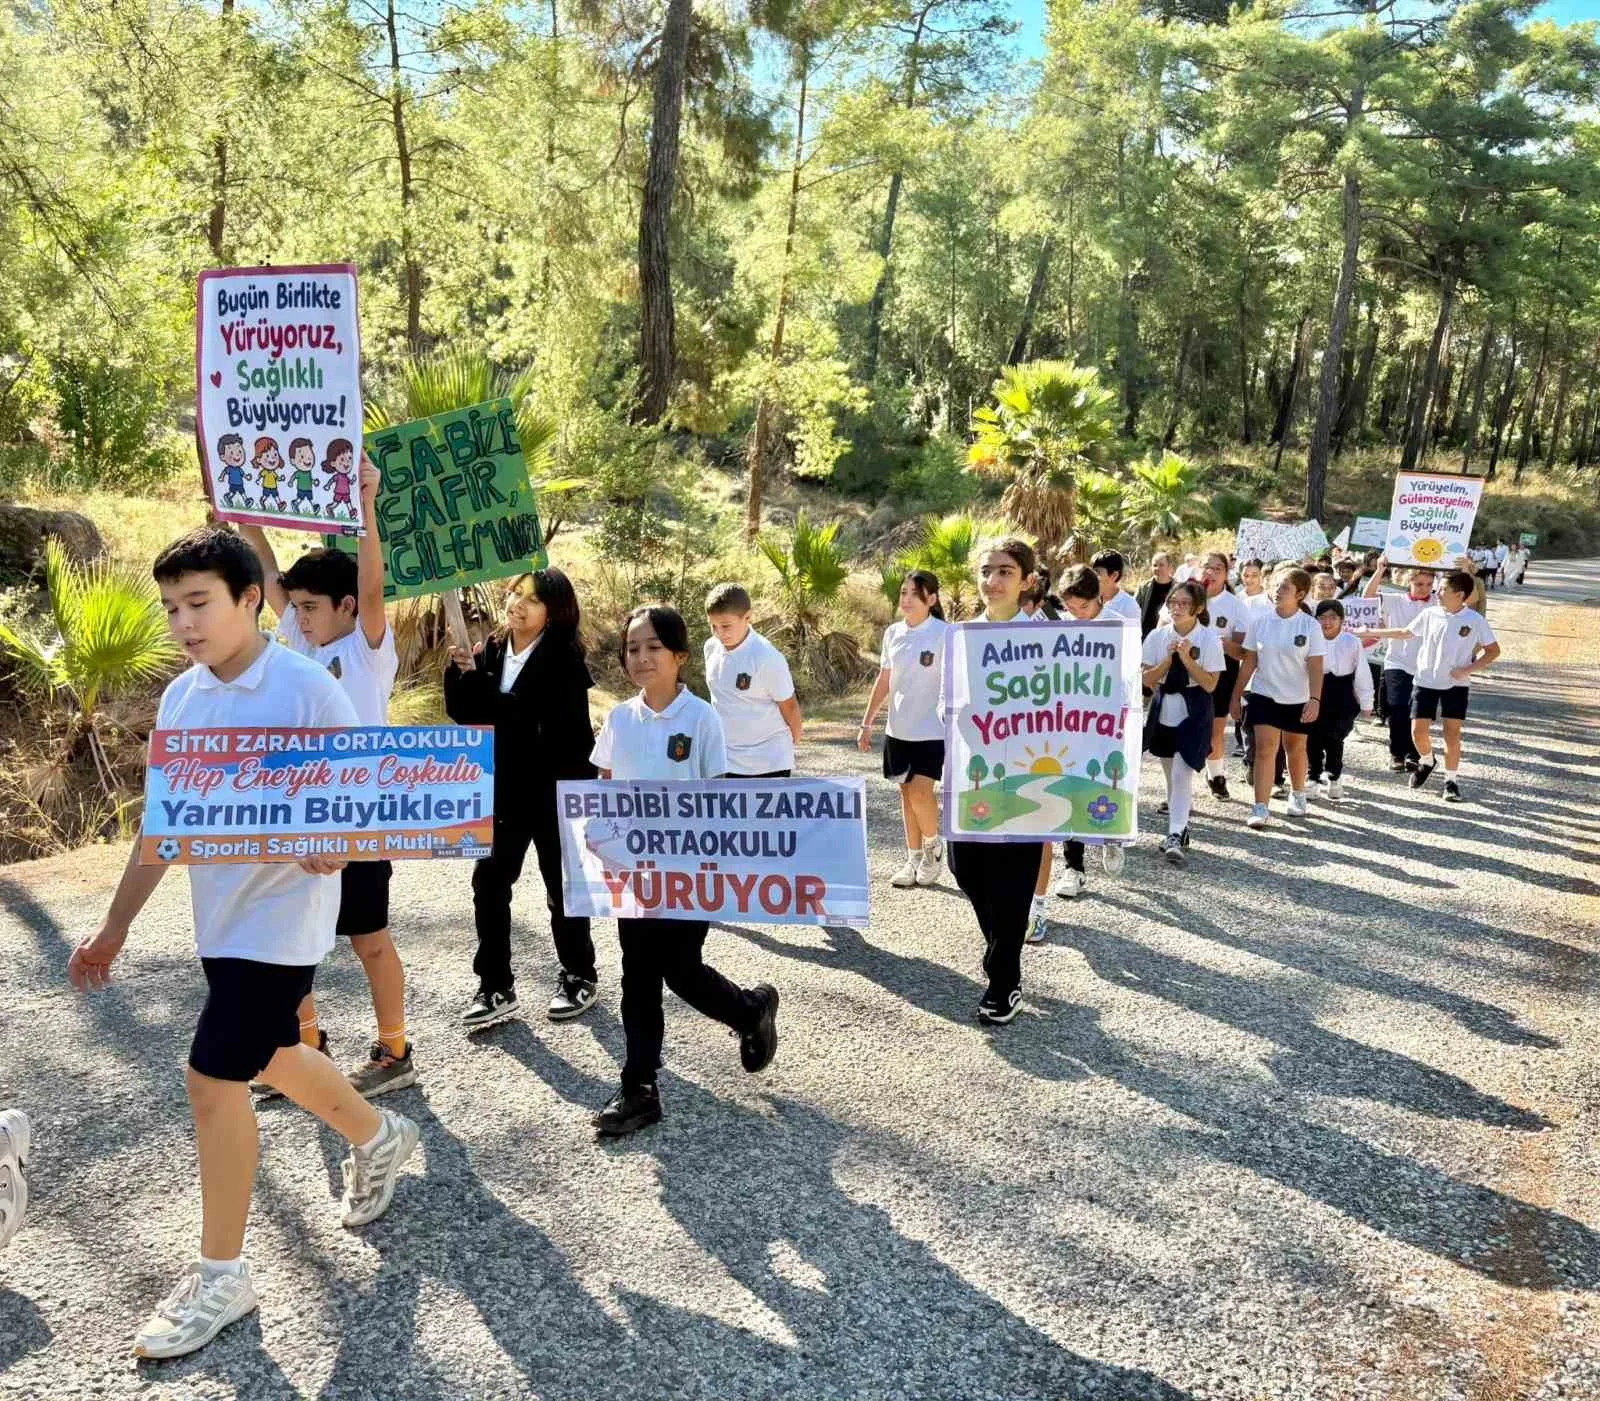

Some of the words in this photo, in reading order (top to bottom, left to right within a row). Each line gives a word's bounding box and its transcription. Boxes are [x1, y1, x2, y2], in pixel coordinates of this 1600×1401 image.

[217, 284, 270, 318] Bugün
[276, 281, 342, 310] Birlikte
[220, 317, 344, 359] Yürüyoruz,
[236, 357, 324, 397] Sağlıklı
[226, 394, 347, 432] Büyüyoruz!
[367, 408, 523, 497] ĞA-BİZE
[1410, 481, 1469, 496] Yürüyelim,
[1400, 519, 1464, 534] Büyüyelim!
[1410, 506, 1457, 521] Sağlıklı
[1345, 604, 1377, 619] üyor
[982, 640, 1043, 667] Adım
[1052, 633, 1115, 660] Adım
[986, 662, 1112, 706] Sağlıklı
[235, 732, 325, 751] ZARALI
[332, 728, 482, 751] ORTAOKULU
[972, 701, 1128, 745] Yarınlara!
[163, 757, 225, 799] Hep
[232, 756, 335, 799] Enerjik
[339, 766, 370, 786] ve
[377, 753, 483, 793] Coşkulu
[161, 799, 292, 827] Yarının
[304, 792, 481, 829] Büyükleri
[564, 786, 671, 819] BELDİBİ
[677, 791, 747, 819] SITKI
[755, 791, 861, 819] ZARALI
[190, 840, 260, 858] Sporla
[267, 838, 348, 857] Sağlıklı
[356, 841, 379, 852] ve
[626, 828, 797, 857] ORTAOKULU
[601, 860, 828, 916] YÜRÜYOR
